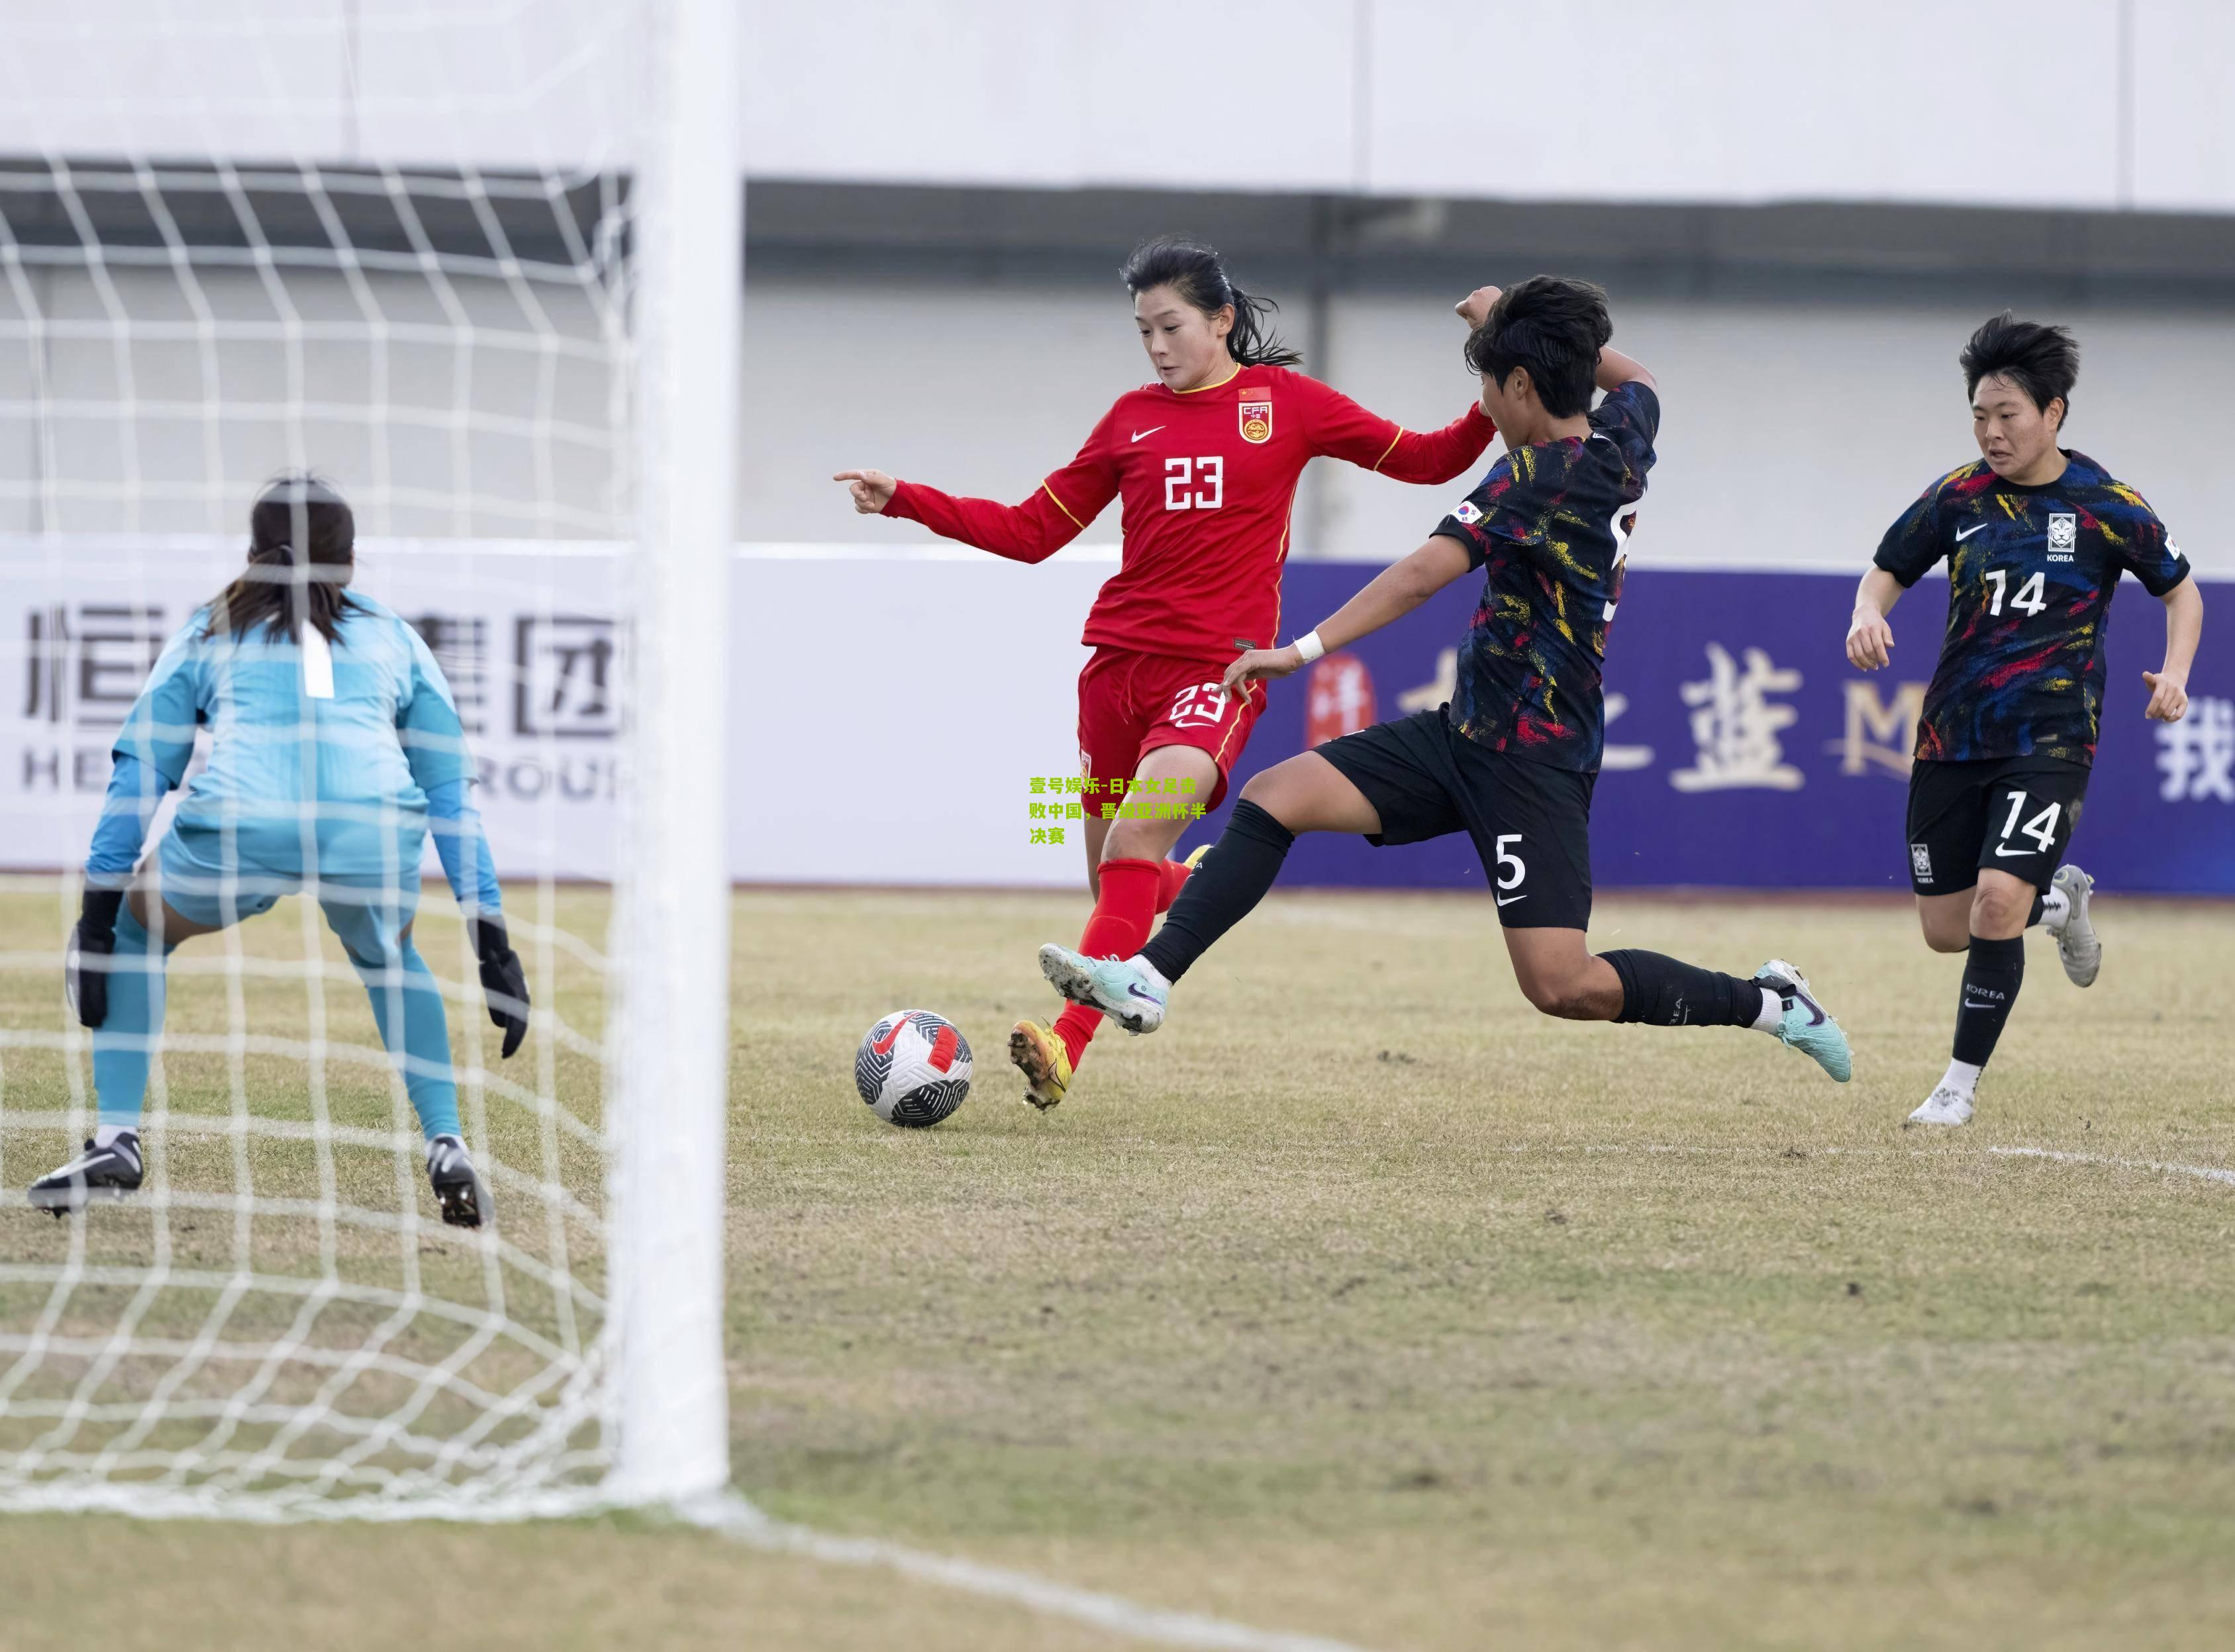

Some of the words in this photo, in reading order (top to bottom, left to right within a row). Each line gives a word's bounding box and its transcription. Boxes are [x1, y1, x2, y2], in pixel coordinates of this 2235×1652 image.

[1243, 406, 1268, 414] CFA
[1165, 456, 1224, 510] 23
[1985, 569, 2047, 617] 14
[1168, 682, 1226, 723] 23
[2000, 791, 2061, 853] 14
[1496, 834, 1526, 890] 5
[1965, 983, 2005, 1000] KOREA
